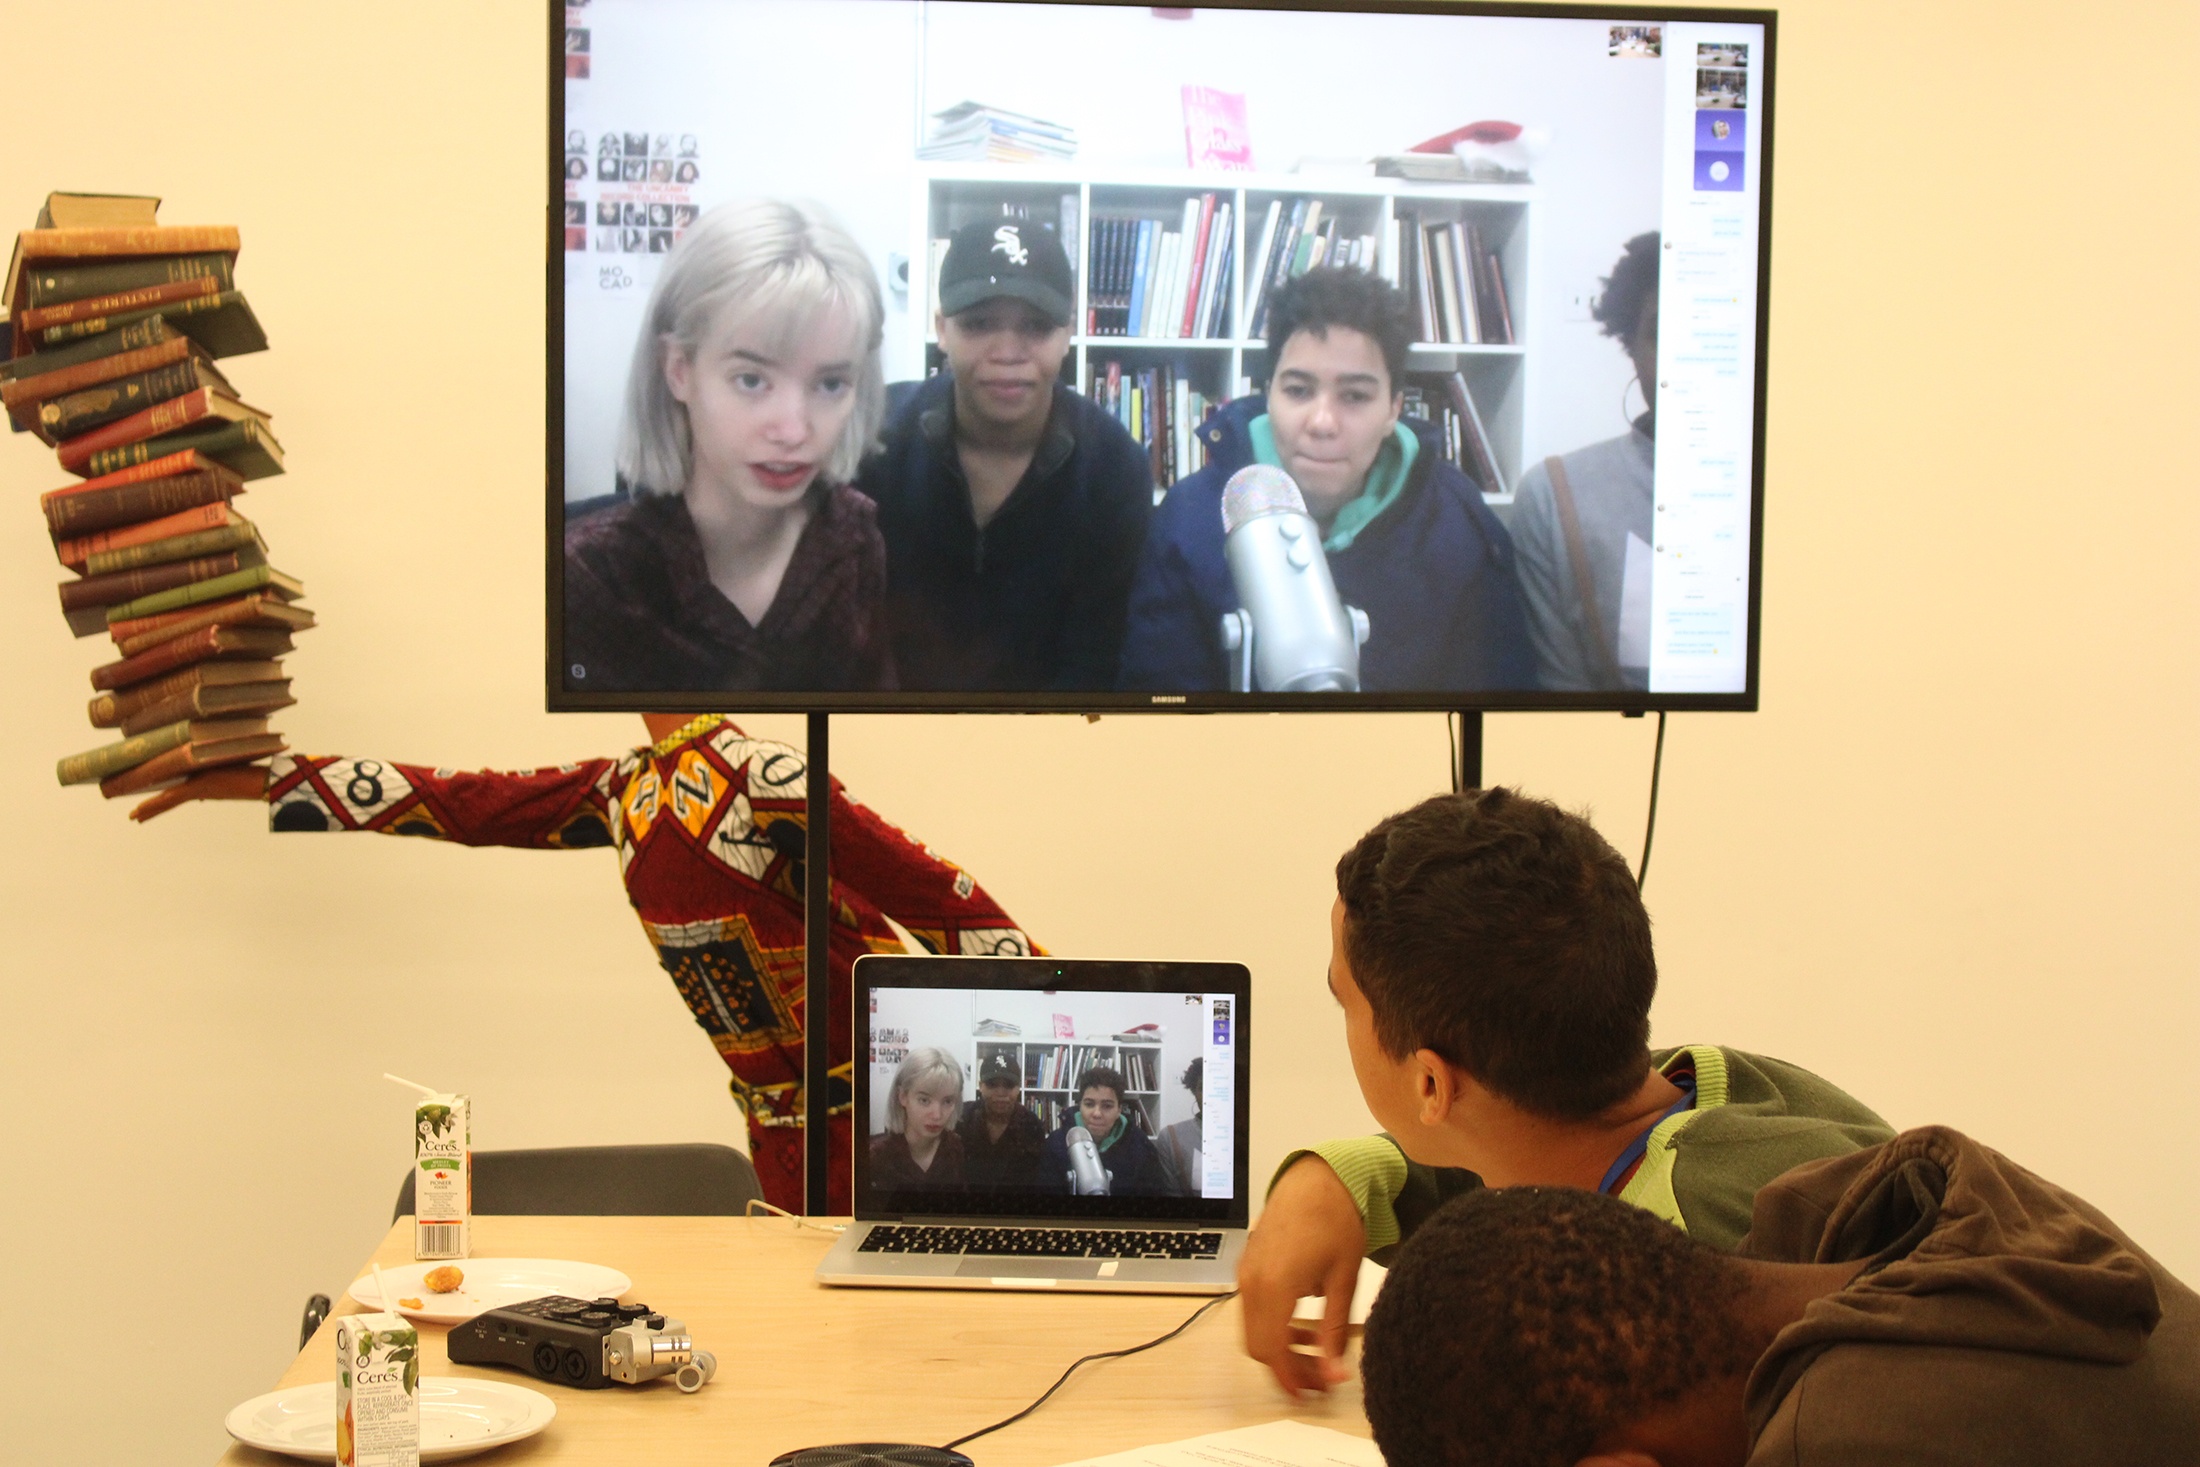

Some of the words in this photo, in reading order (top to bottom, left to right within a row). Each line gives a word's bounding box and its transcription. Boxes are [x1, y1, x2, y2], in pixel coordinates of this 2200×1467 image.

[1151, 695, 1187, 704] SAMSUNG
[347, 760, 383, 807] 8
[425, 1141, 457, 1151] Ceres
[357, 1371, 398, 1385] Ceres
